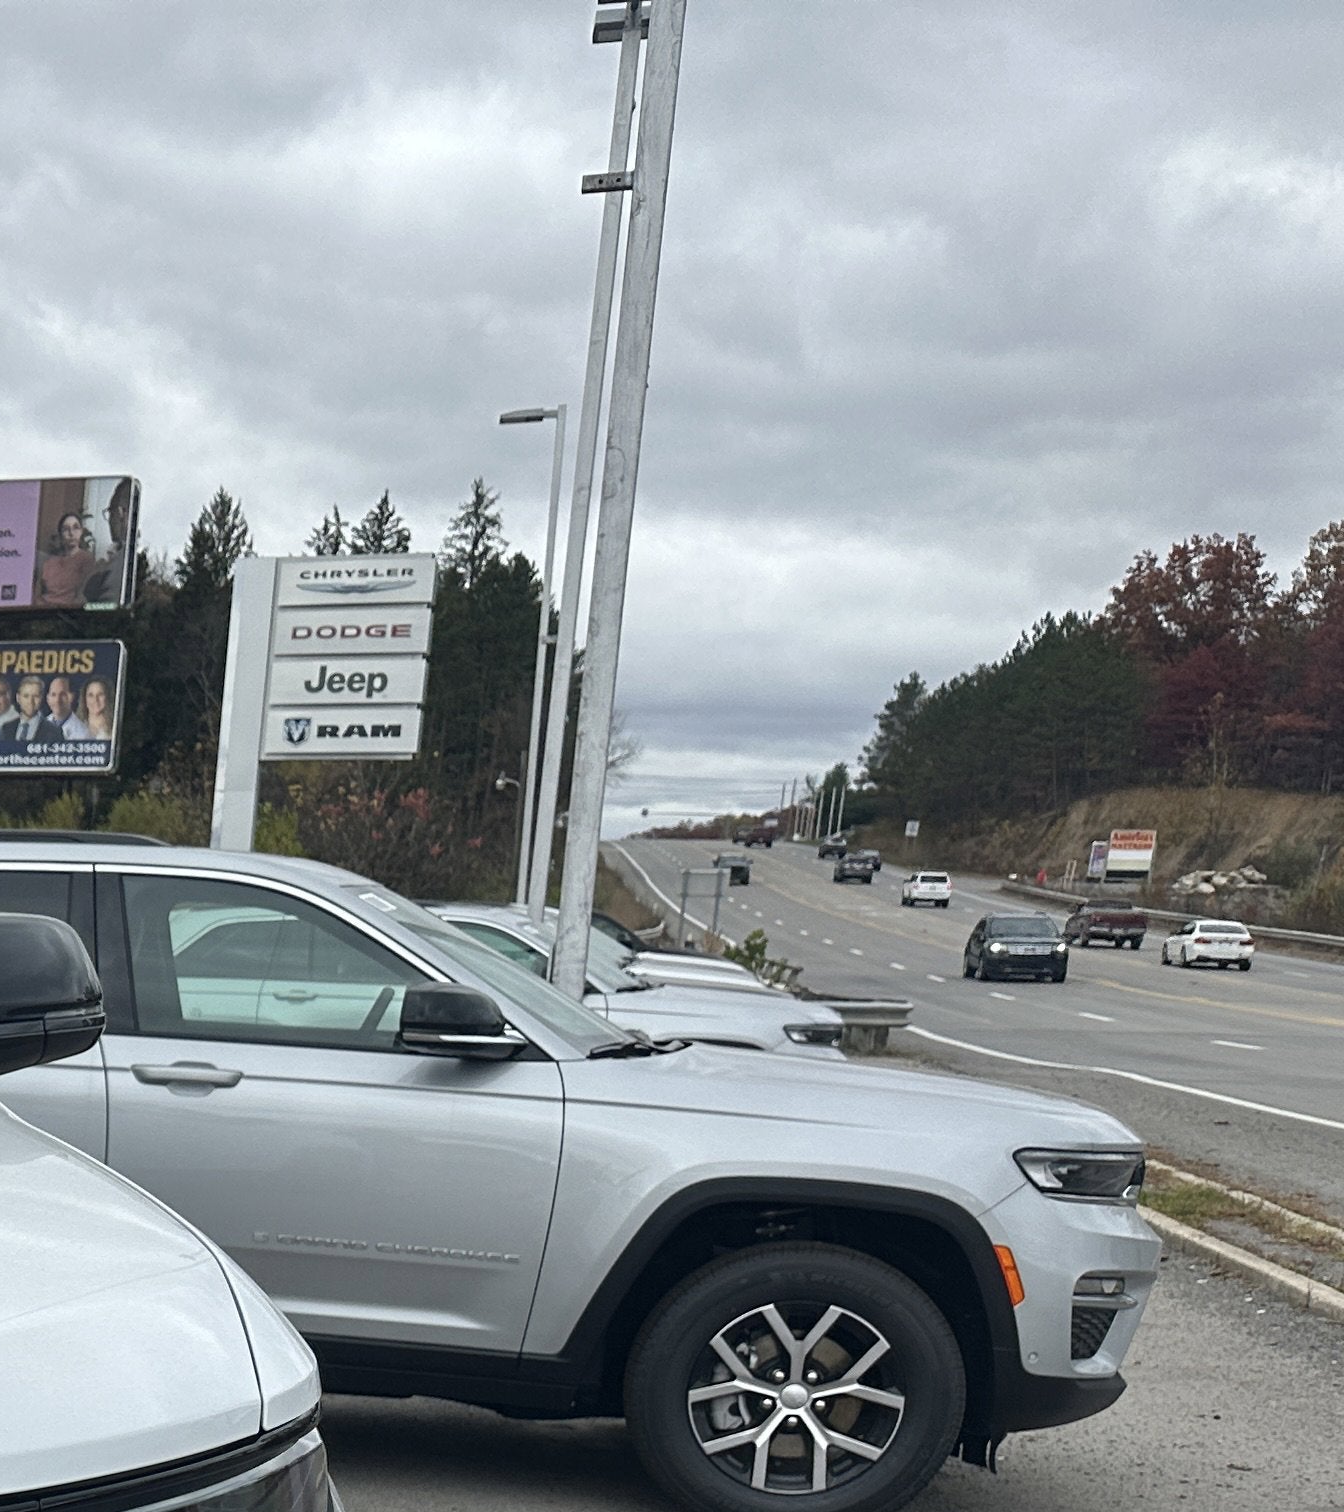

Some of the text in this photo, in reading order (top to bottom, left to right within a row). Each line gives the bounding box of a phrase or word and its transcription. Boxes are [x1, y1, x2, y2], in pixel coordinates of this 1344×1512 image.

[299, 568, 415, 580] CHRYSLER
[291, 624, 412, 640] DODGE
[304, 664, 388, 698] Jeep
[316, 723, 402, 738] RAM
